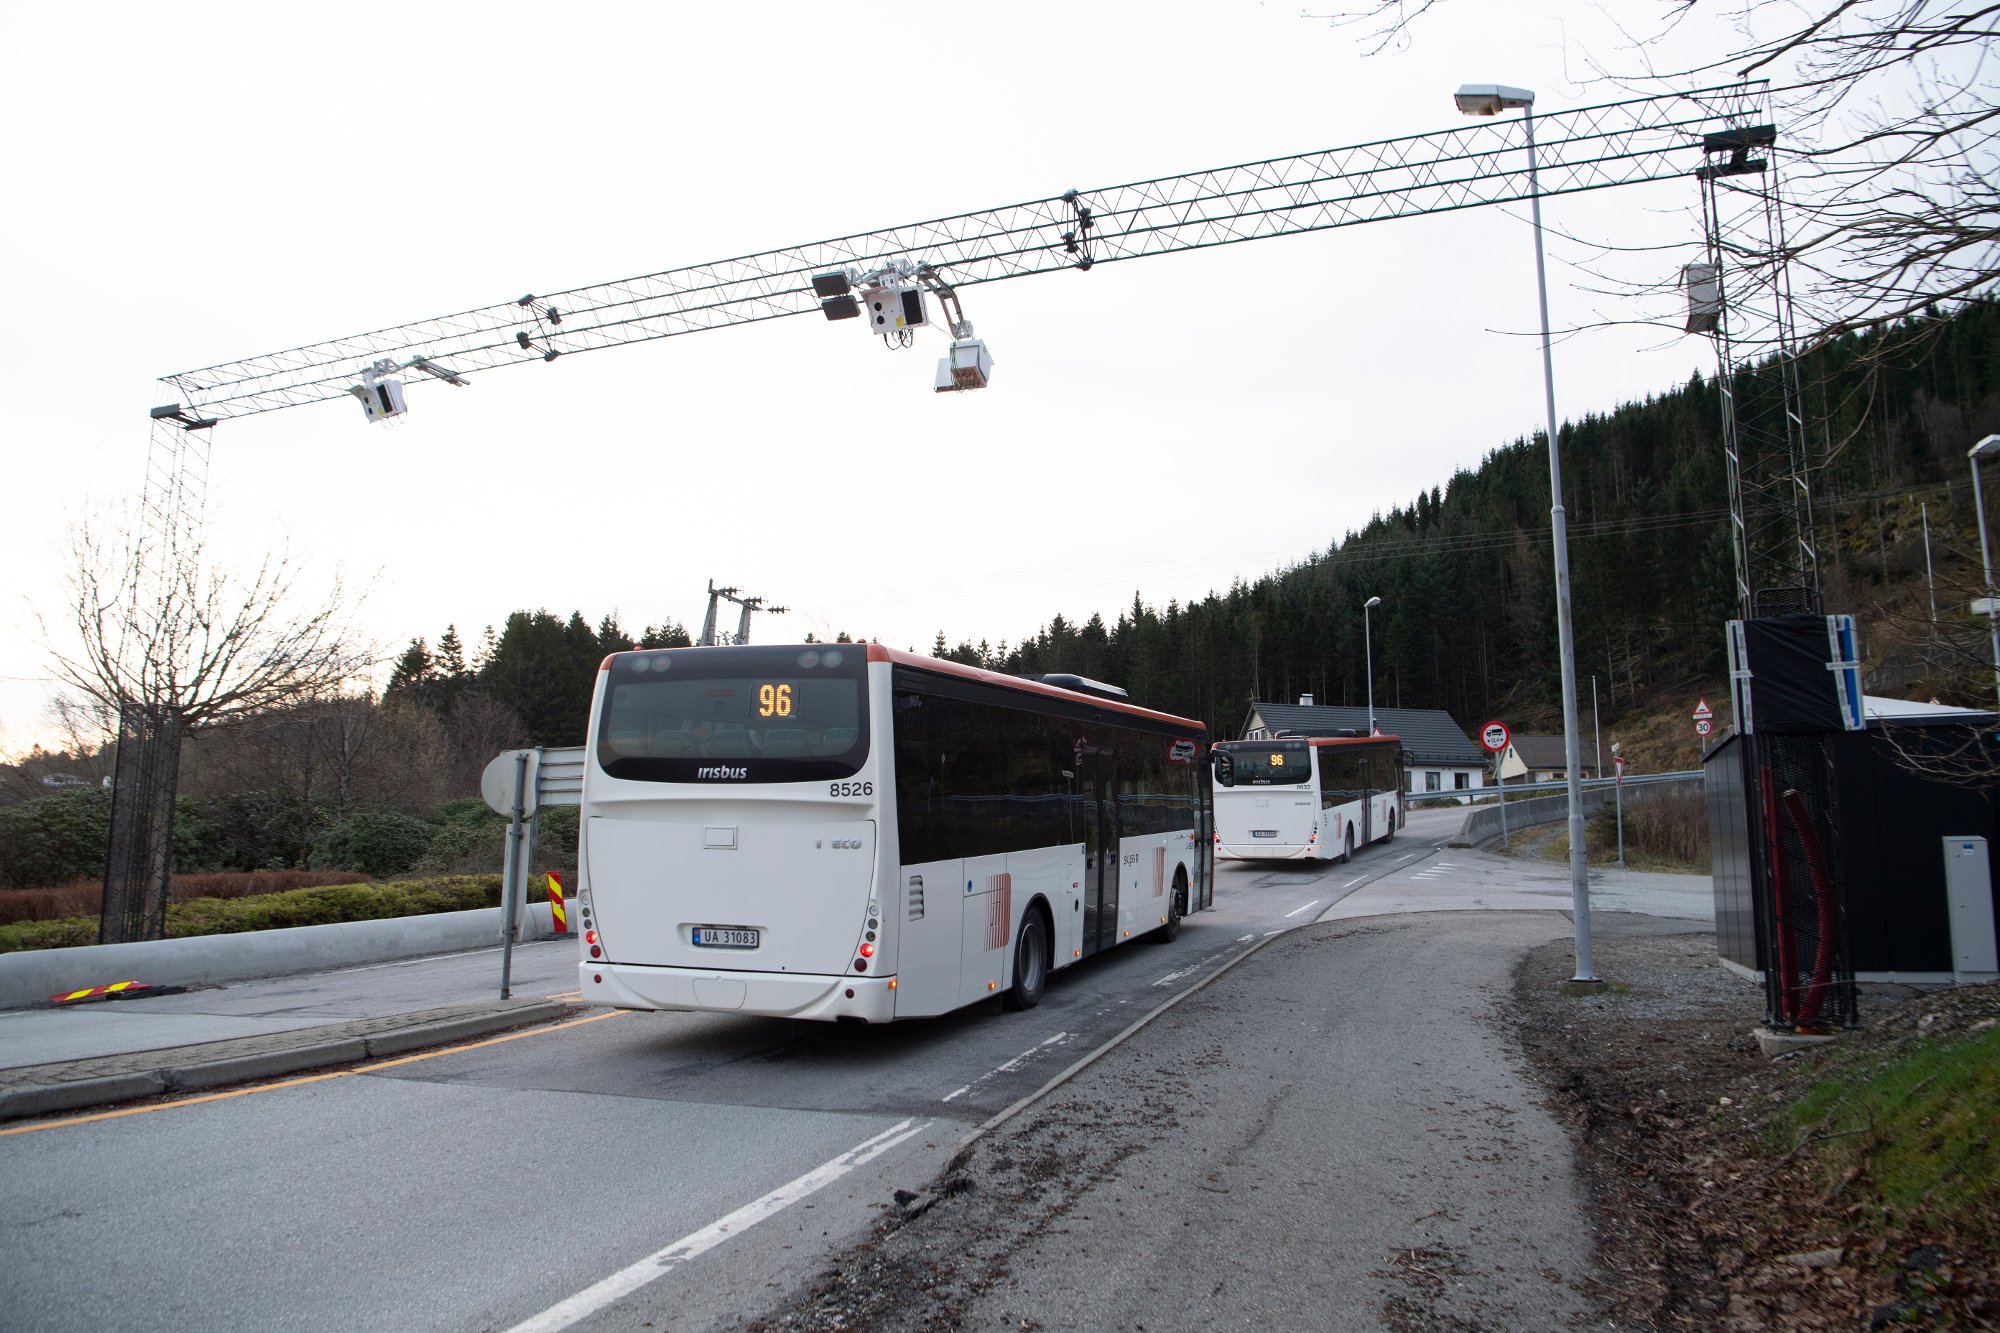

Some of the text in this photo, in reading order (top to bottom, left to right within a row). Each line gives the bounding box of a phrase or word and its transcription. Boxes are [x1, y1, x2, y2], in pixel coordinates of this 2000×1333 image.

[760, 684, 791, 716] 96
[1698, 723, 1709, 731] 30
[1271, 754, 1283, 766] 96
[830, 782, 873, 797] 8526
[704, 930, 756, 944] UA 31083
